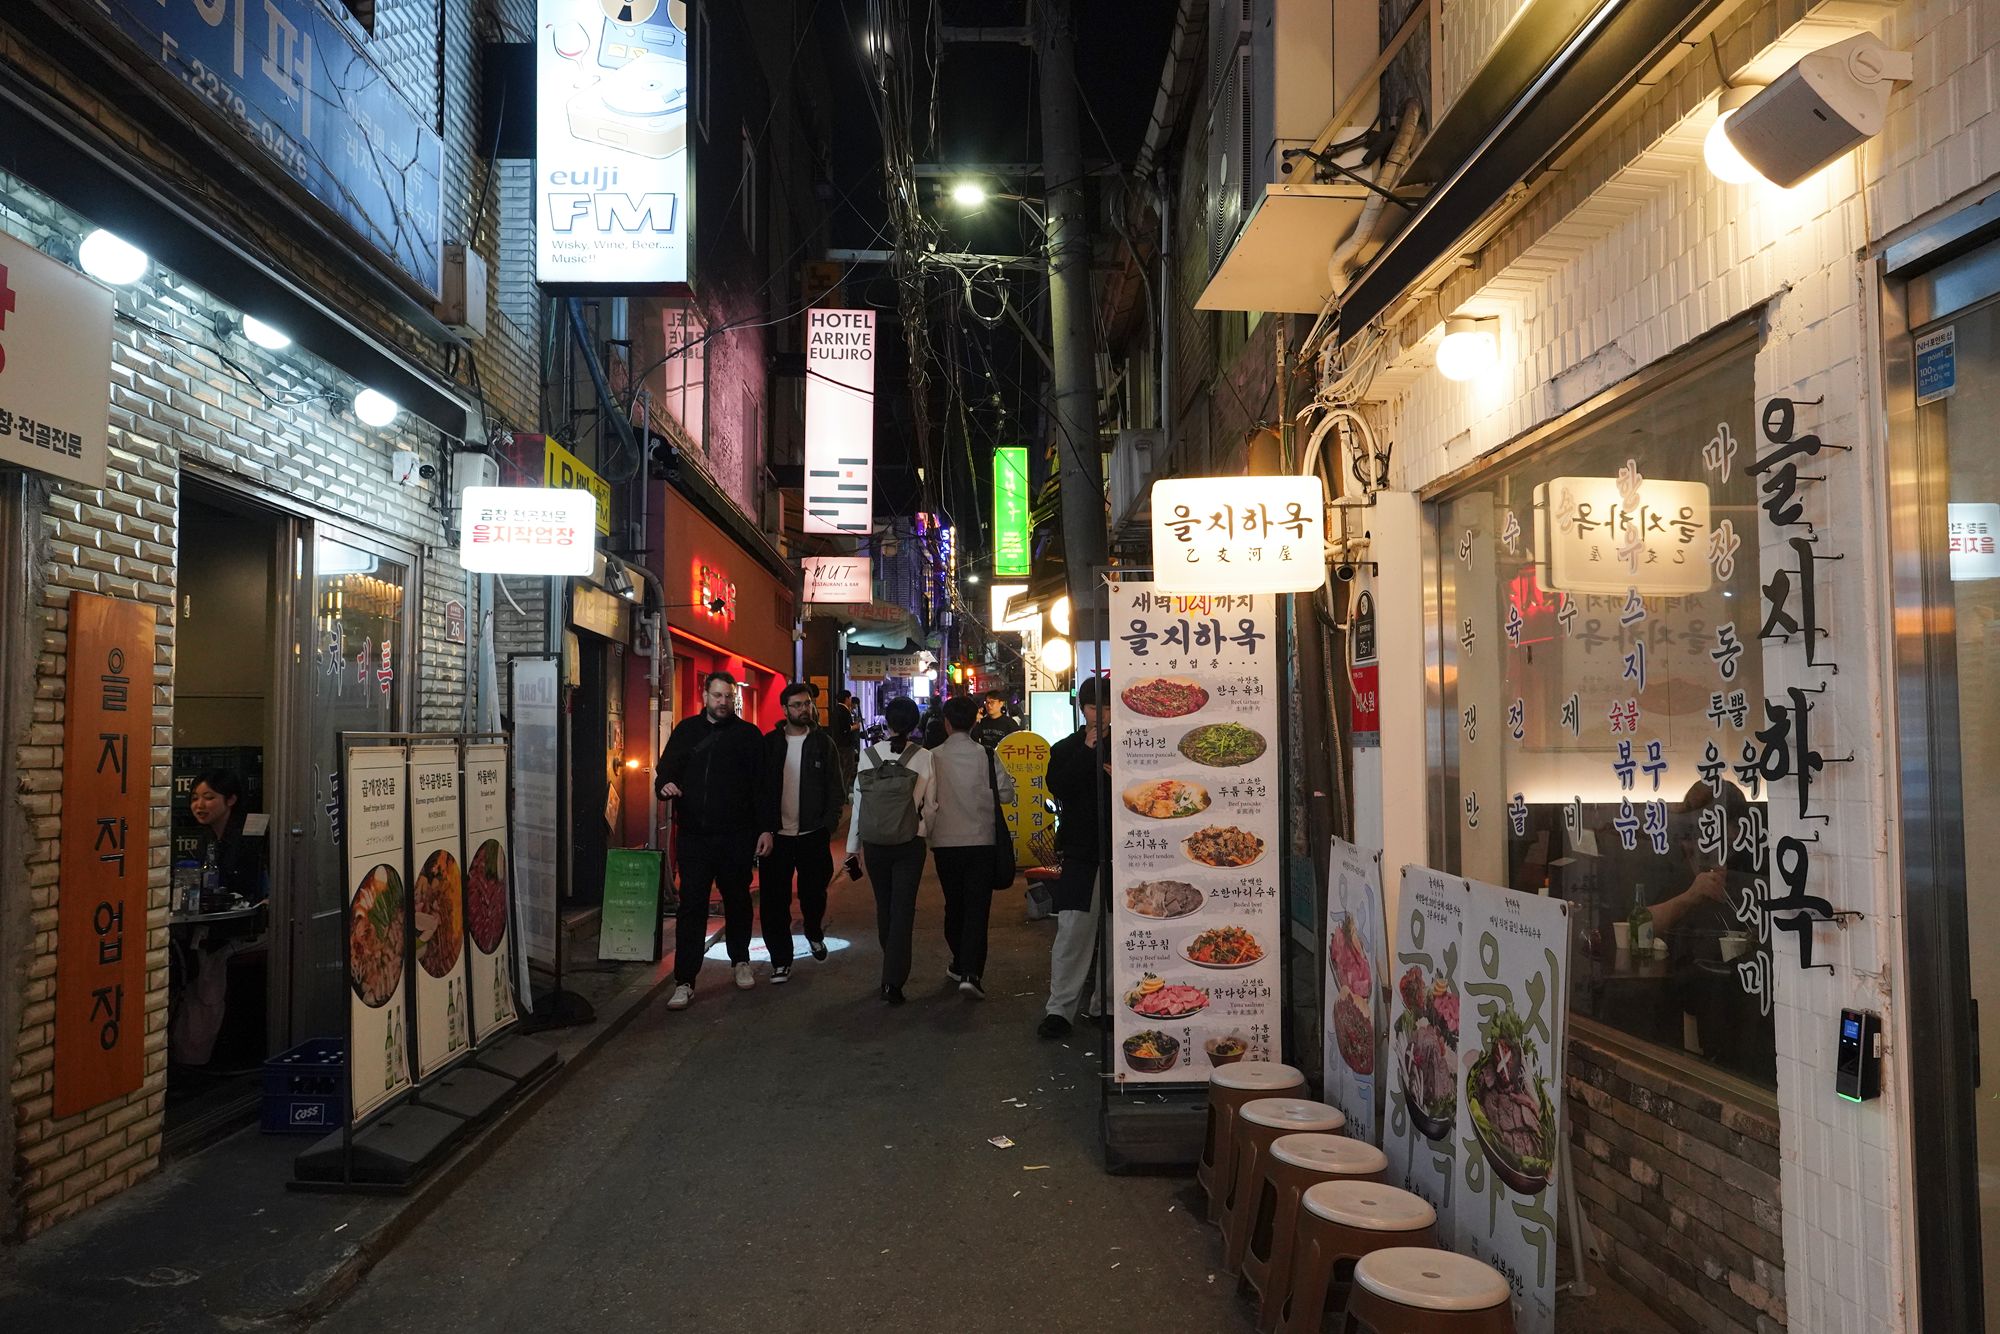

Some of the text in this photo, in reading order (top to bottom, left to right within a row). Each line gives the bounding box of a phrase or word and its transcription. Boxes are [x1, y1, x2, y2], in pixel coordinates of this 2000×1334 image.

[550, 166, 618, 191] eulji
[548, 193, 678, 235] FM
[812, 313, 872, 328] HOTEL
[811, 332, 870, 346] ARRIVE
[810, 348, 872, 361] EULJIRO
[1164, 502, 1313, 542] 을지하옥
[472, 524, 575, 545] 을지작업장
[1703, 423, 1743, 681] 마장동
[815, 564, 858, 580] MUT
[1132, 592, 1171, 613] 새벽
[451, 621, 460, 636] 26
[1120, 619, 1265, 656] 을지하옥
[1169, 659, 1219, 670] 영업중
[1503, 512, 1527, 834] 수육전골
[1459, 530, 1480, 828] 어복쟁반
[1744, 398, 1833, 968] 을지하옥
[1216, 684, 1265, 696] 한우 육회
[1609, 701, 1639, 732] 숯불
[1709, 694, 1747, 728] 투뿔
[1002, 744, 1048, 760] 주마등
[1122, 737, 1167, 749] 미나리전
[419, 772, 453, 791] 한우곱창모듬
[477, 769, 497, 785] 차돌박이
[361, 778, 395, 798] 곱개장전골
[1244, 786, 1267, 798] 육전
[1613, 740, 1639, 850] 볶음
[1642, 741, 1669, 854] 무침
[1698, 743, 1727, 865] 육회
[89, 648, 130, 1051] 을지작업장
[1124, 839, 1169, 851] 스지볶음
[1734, 741, 1770, 1015] 육사시미
[1210, 887, 1277, 899] 소한마리 수육
[1125, 939, 1169, 951] 한우무침
[1214, 987, 1271, 999] 참다랑어 회
